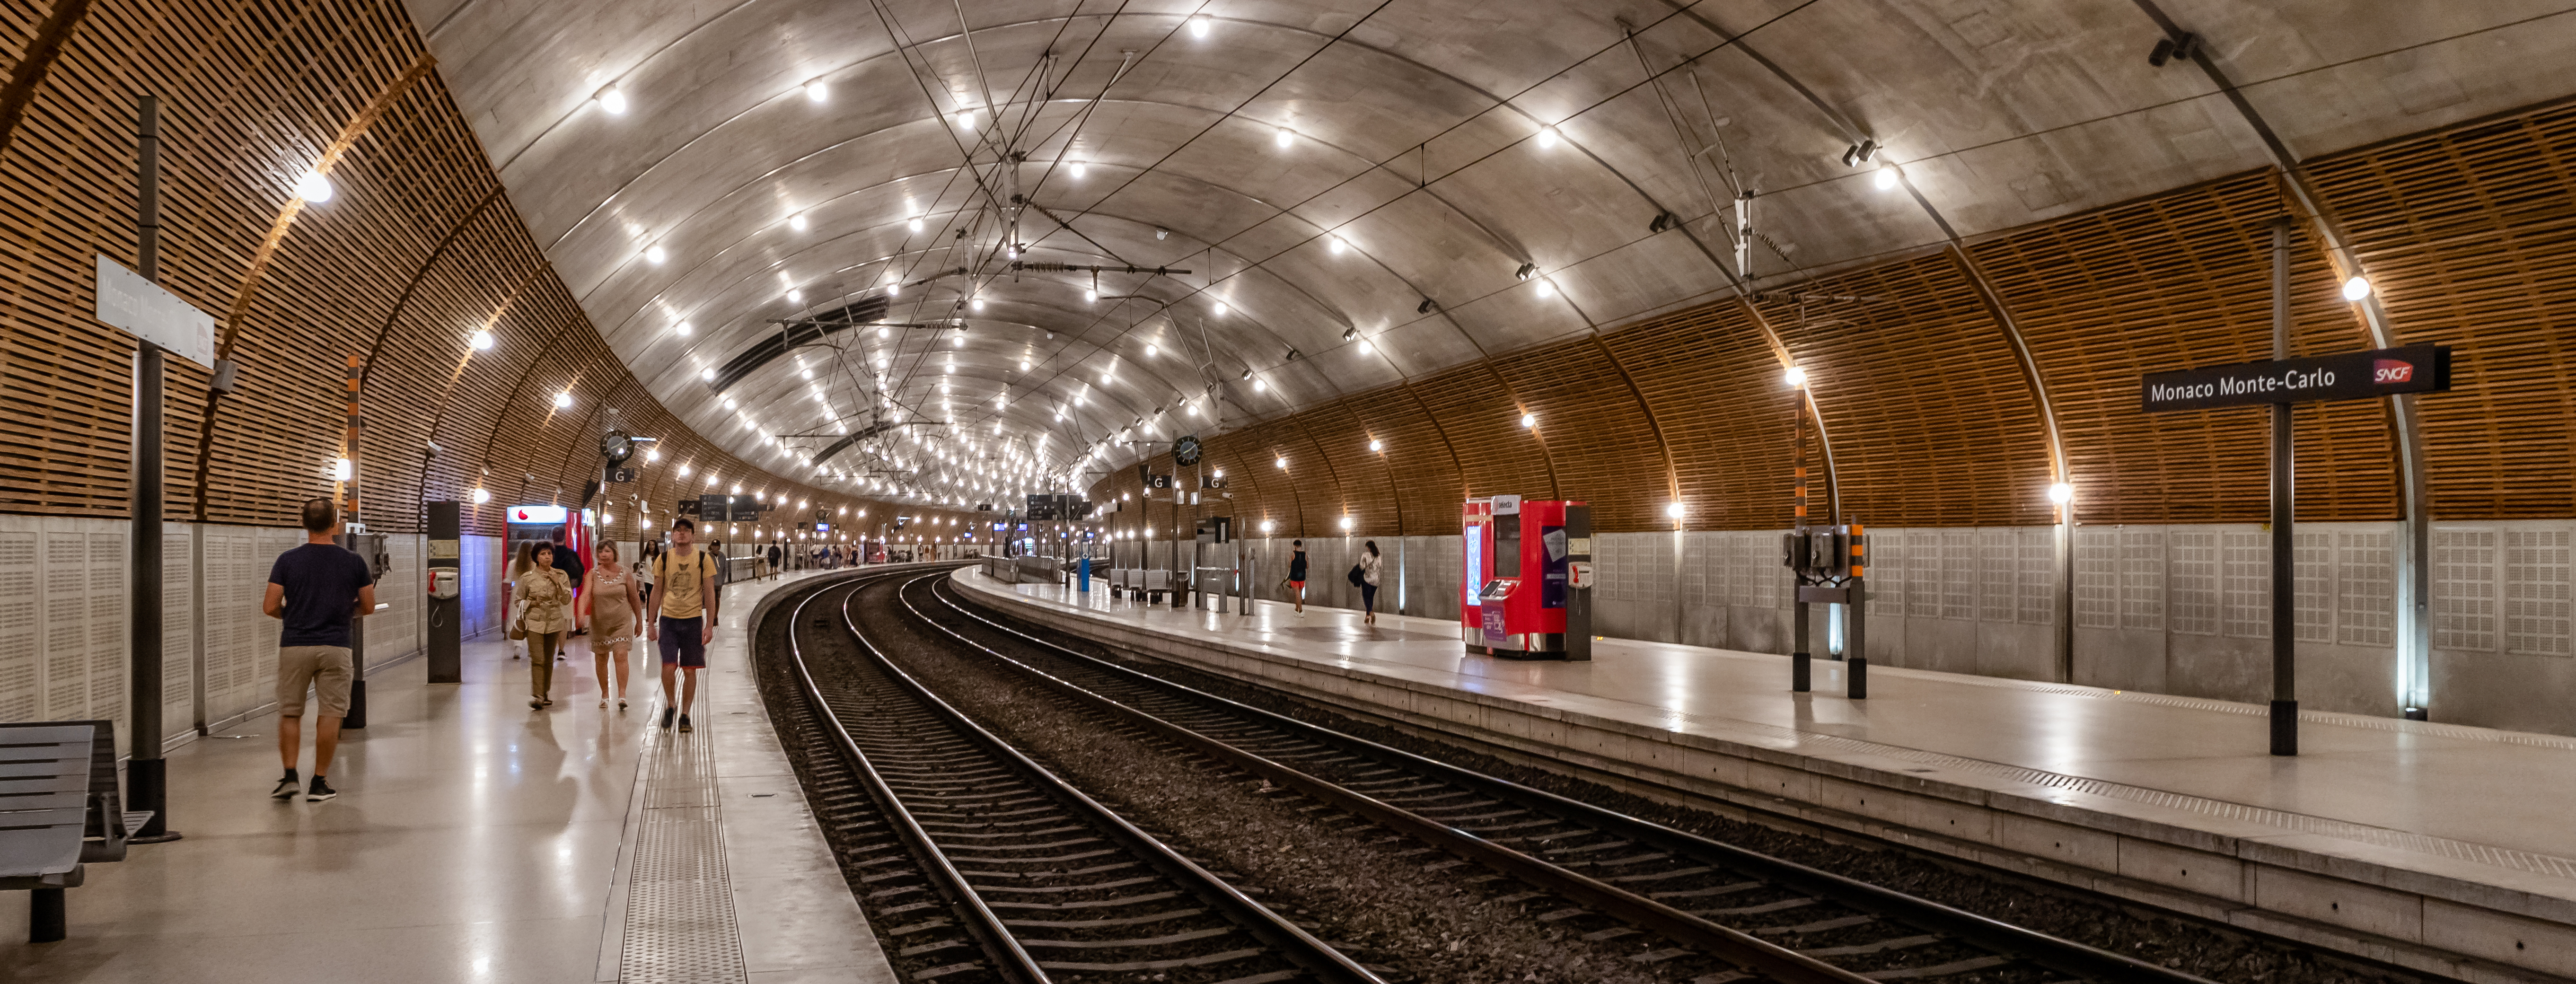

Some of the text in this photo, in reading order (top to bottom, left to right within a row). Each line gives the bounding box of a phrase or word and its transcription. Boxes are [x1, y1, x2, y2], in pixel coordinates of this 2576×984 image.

[2375, 366, 2410, 381] SNCF
[2151, 367, 2335, 402] Monaco Monte-Carlo
[615, 471, 624, 482] G
[1155, 478, 1162, 488] G
[1211, 478, 1219, 488] G
